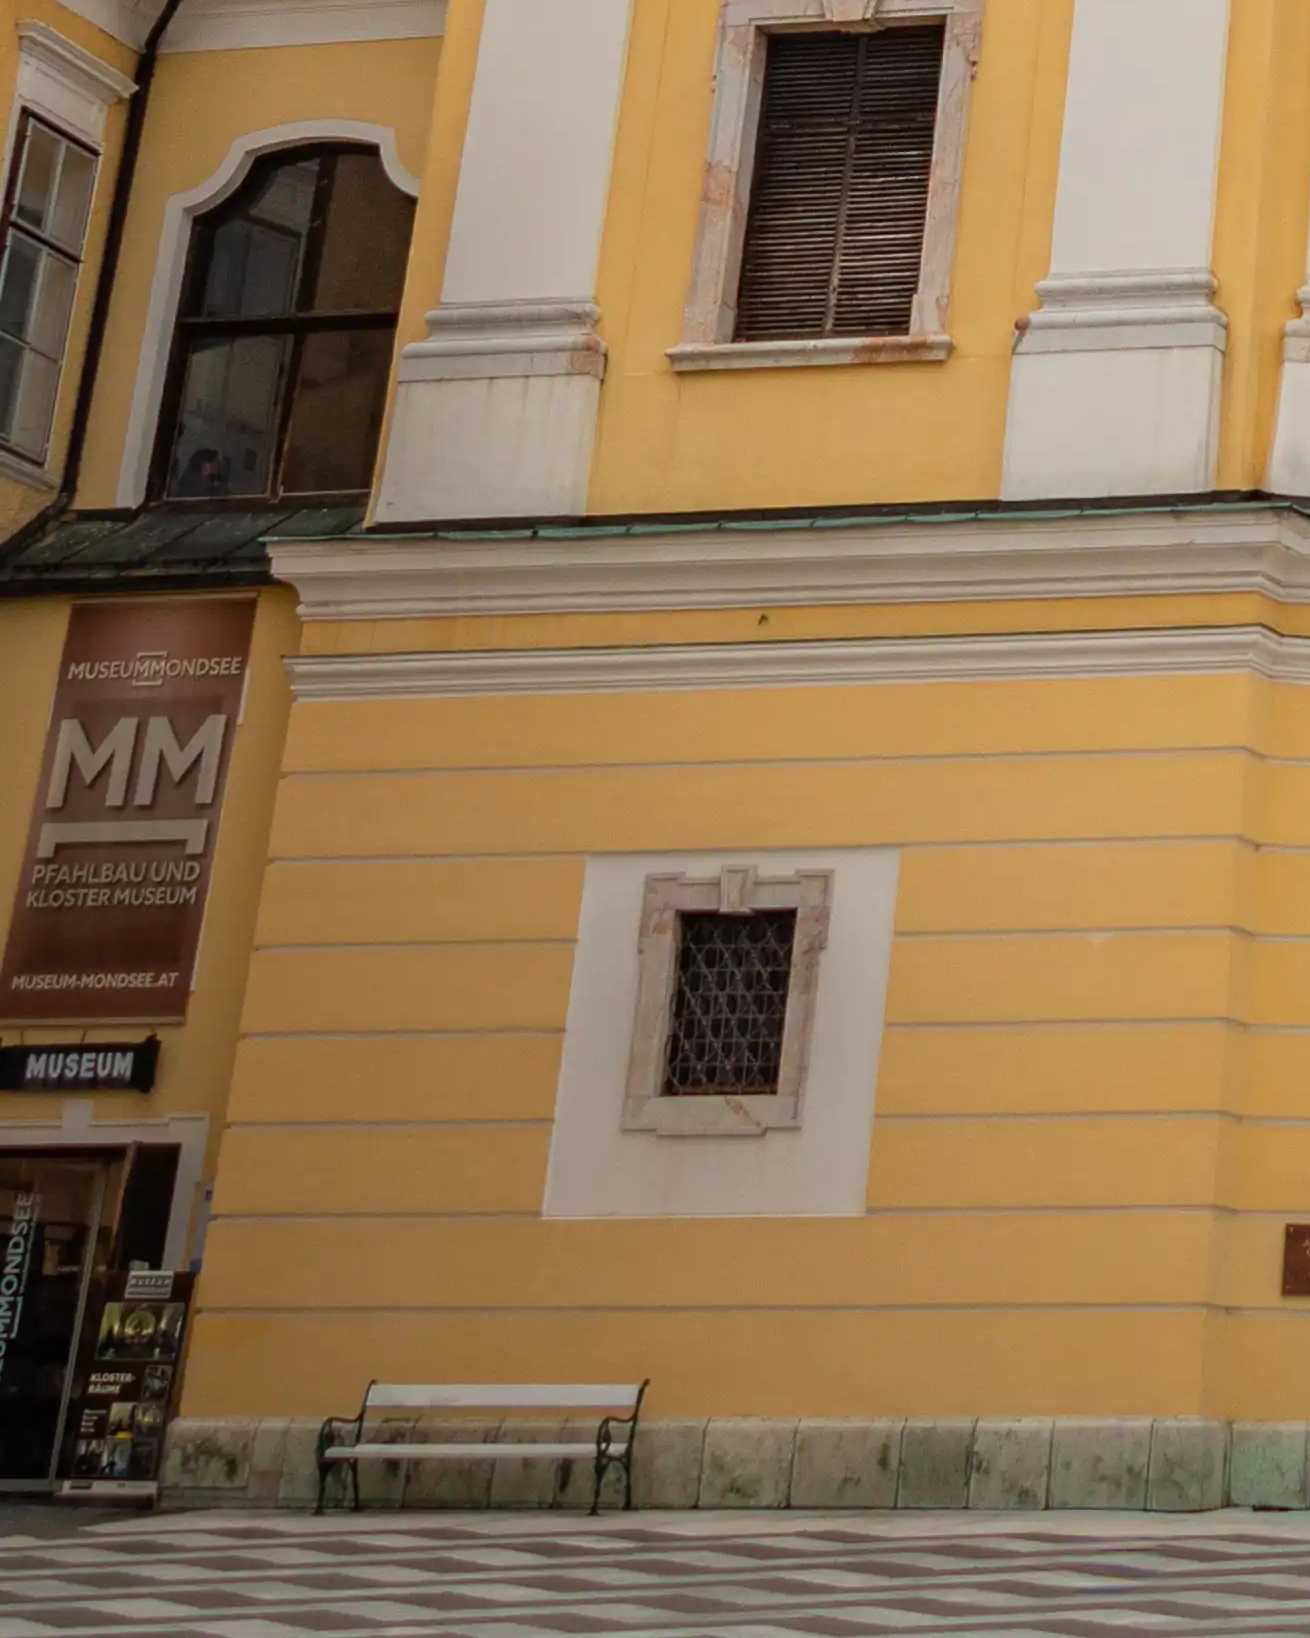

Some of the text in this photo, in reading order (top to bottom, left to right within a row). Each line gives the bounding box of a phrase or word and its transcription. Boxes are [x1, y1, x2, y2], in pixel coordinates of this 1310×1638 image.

[68, 656, 242, 680] MUSEUMMONDSEE
[46, 714, 227, 809] MM
[32, 860, 201, 884] PFAHLBAU UND
[27, 886, 198, 908] KLOSTER MUSEUM
[11, 972, 180, 990] MUSEUM-MONDSEE.AT
[25, 1052, 135, 1080] MUSEUM
